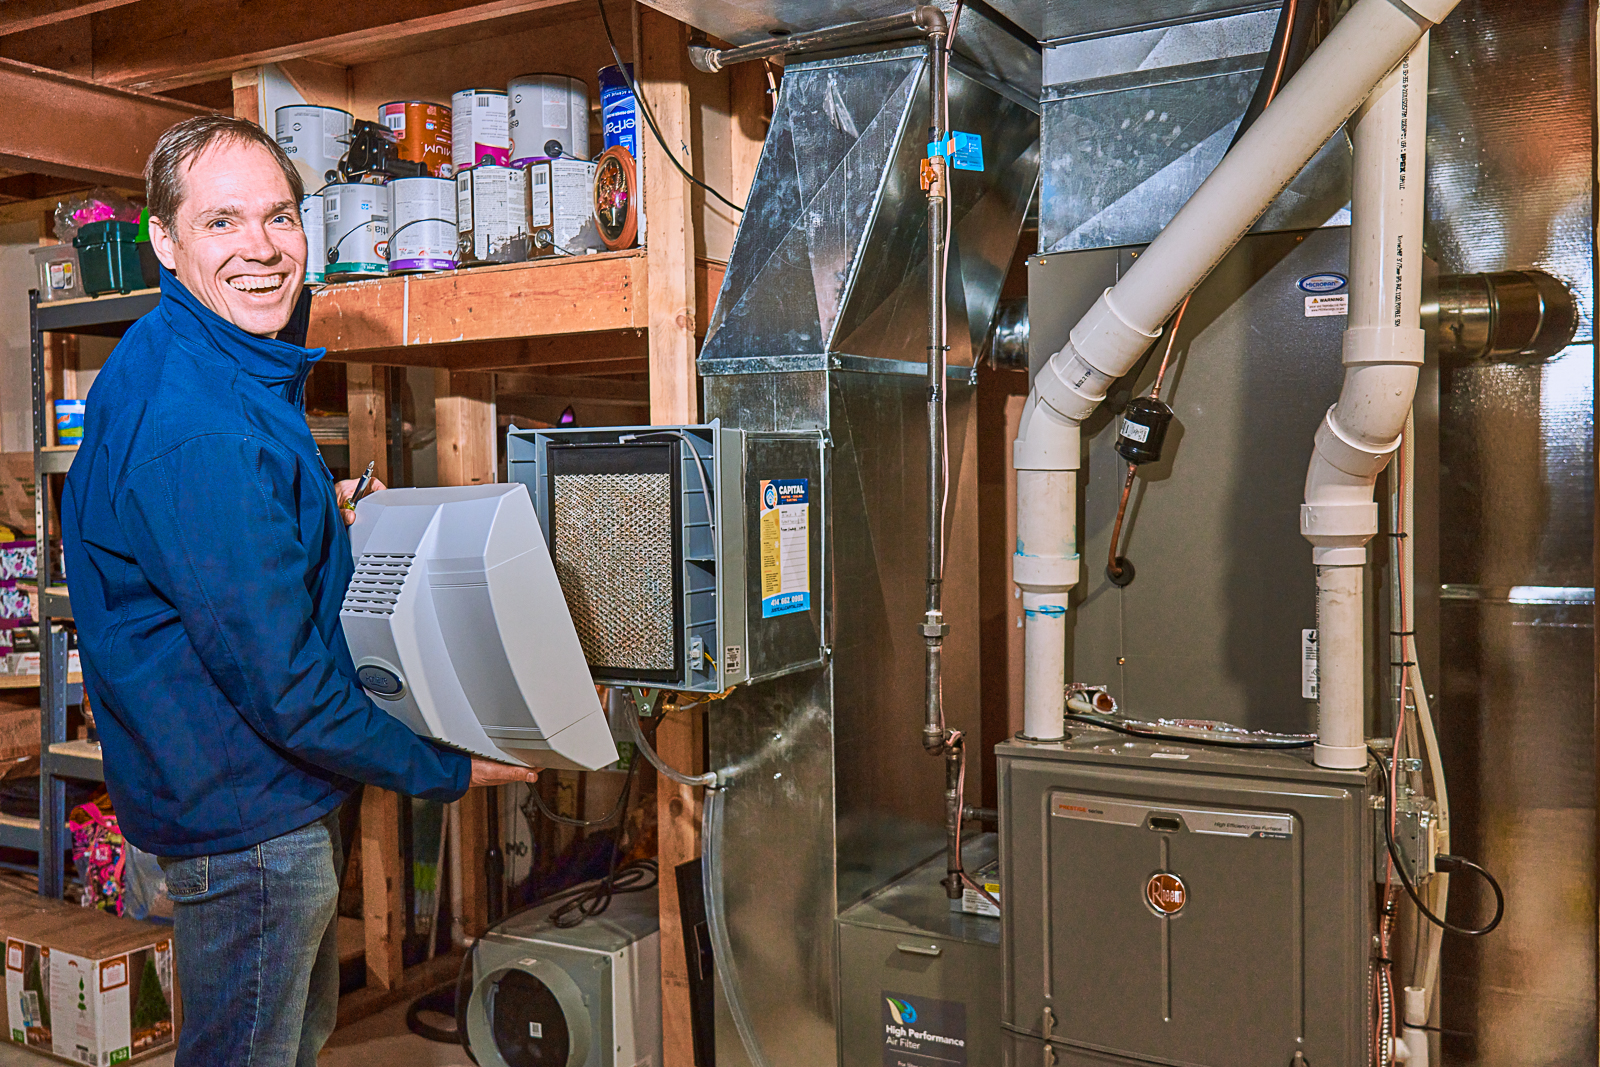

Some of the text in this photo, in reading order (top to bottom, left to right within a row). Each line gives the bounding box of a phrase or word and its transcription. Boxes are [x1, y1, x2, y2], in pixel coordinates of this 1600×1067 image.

[1399, 152, 1407, 173] IPEX
[778, 485, 805, 495] CAPITAL
[1058, 804, 1088, 812] PRESTIGE
[1226, 822, 1250, 830] Efficiency
[1151, 876, 1183, 907] Rheem
[885, 1024, 965, 1047] High Performance
[885, 1036, 921, 1050] Air Filter
